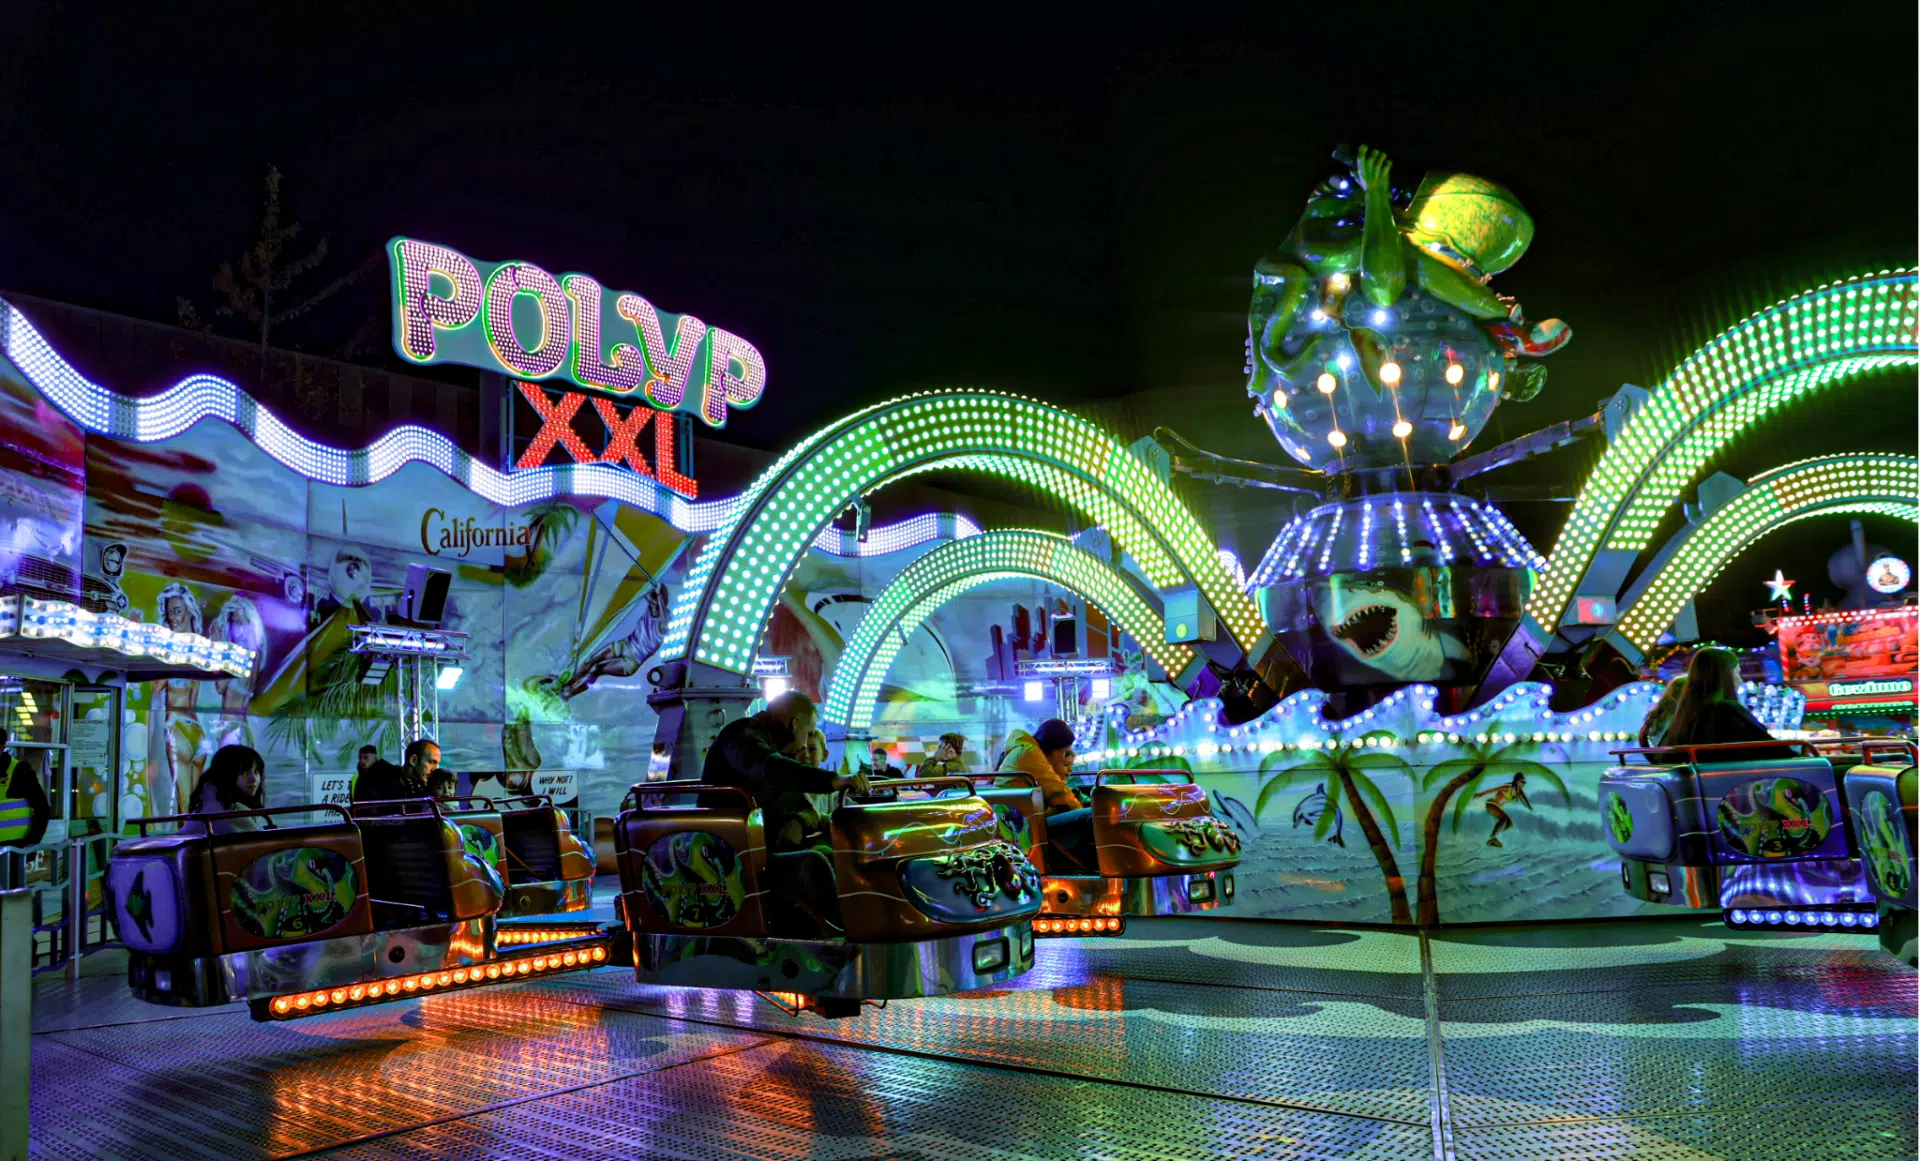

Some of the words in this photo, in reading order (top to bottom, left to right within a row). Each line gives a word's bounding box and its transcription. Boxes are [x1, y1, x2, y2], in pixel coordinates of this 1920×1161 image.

[394, 239, 766, 427] POLYP
[514, 381, 698, 499] XXL
[420, 507, 531, 557] California
[321, 780, 344, 791] LET'S
[539, 776, 555, 784] WHY
[556, 775, 573, 784] NOT?
[548, 787, 567, 795] WILL
[322, 794, 329, 804] A
[331, 793, 350, 804] RIDE
[1782, 818, 1811, 830] XXL
[1773, 840, 1783, 852] 3
[303, 891, 333, 905] XXL
[292, 917, 303, 929] 6
